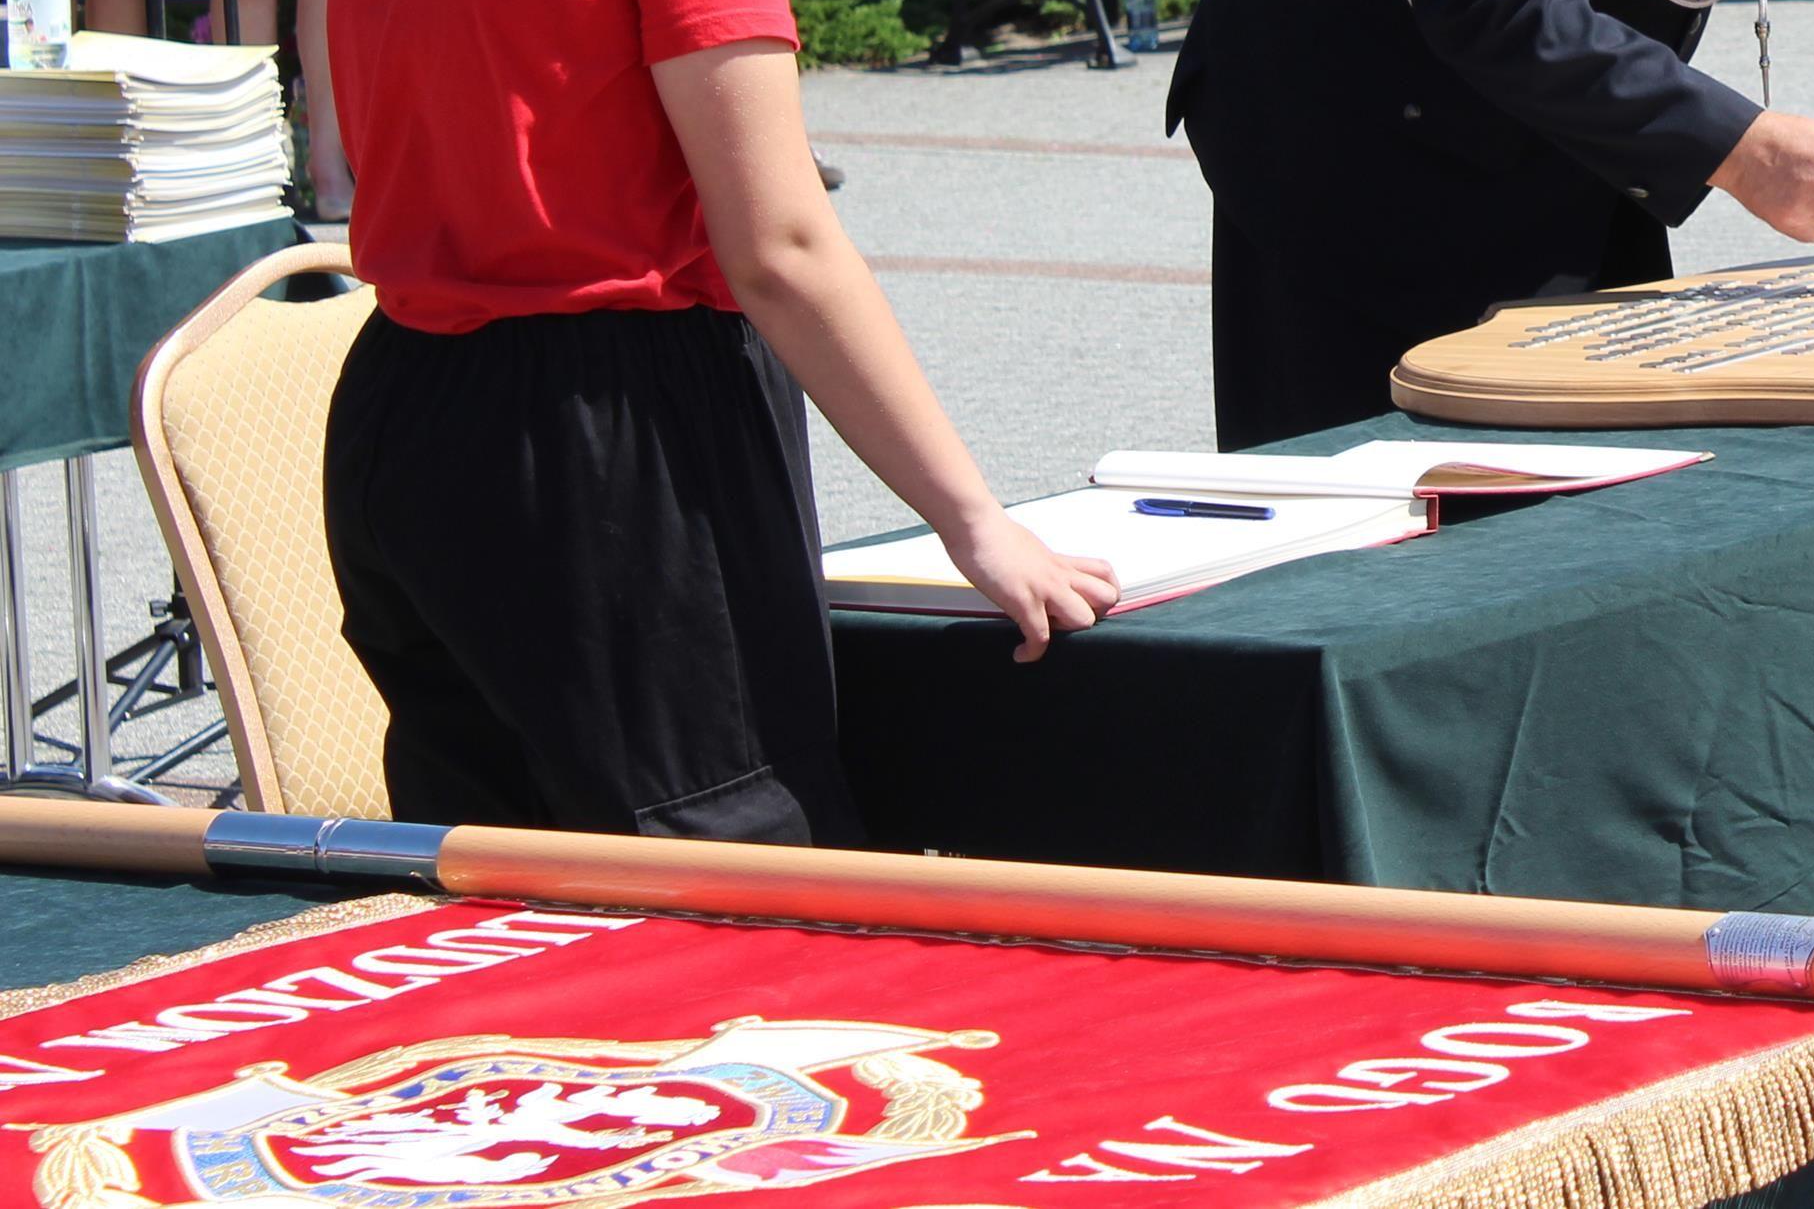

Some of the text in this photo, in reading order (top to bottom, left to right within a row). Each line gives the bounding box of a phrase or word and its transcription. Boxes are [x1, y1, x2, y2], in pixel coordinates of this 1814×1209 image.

[39, 910, 646, 1053] LUDZIOM
[1018, 999, 1692, 1182] BOGU NA
